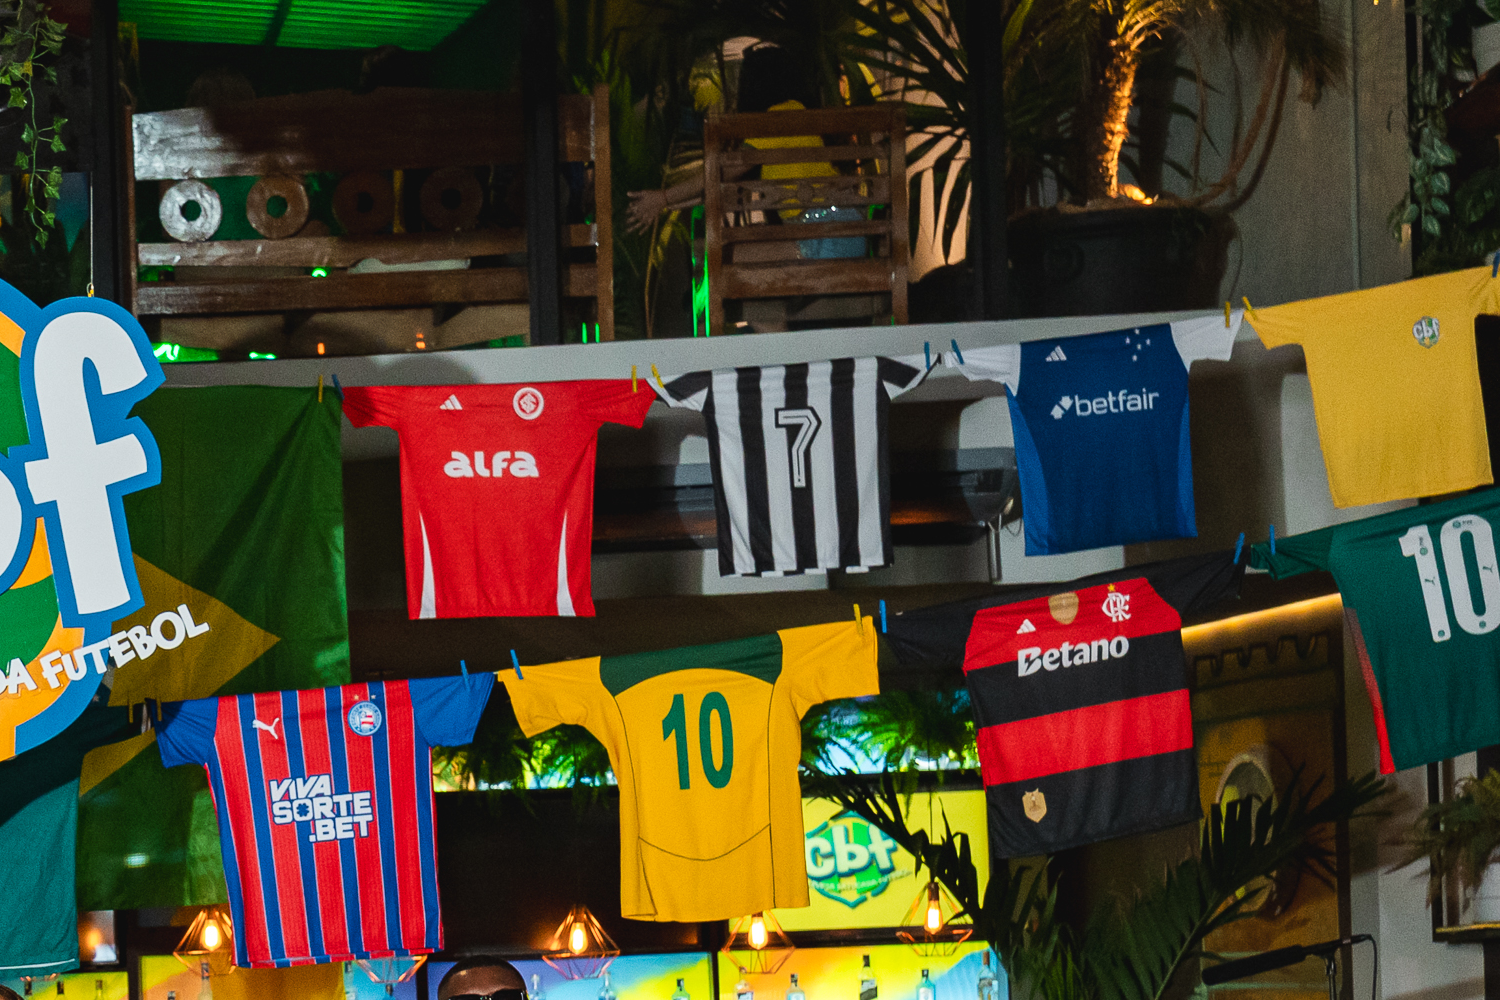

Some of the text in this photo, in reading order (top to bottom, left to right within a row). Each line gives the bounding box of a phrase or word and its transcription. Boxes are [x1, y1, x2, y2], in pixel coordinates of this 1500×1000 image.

[1074, 387, 1160, 417] betfair
[443, 450, 540, 478] alfa
[774, 406, 822, 488] 7
[1398, 514, 1500, 643] 10
[41, 603, 211, 689] FUTEBOL
[1017, 635, 1130, 678] Betano
[662, 691, 734, 790] 10
[269, 774, 332, 802] VIVA
[272, 791, 374, 825] SORTE
